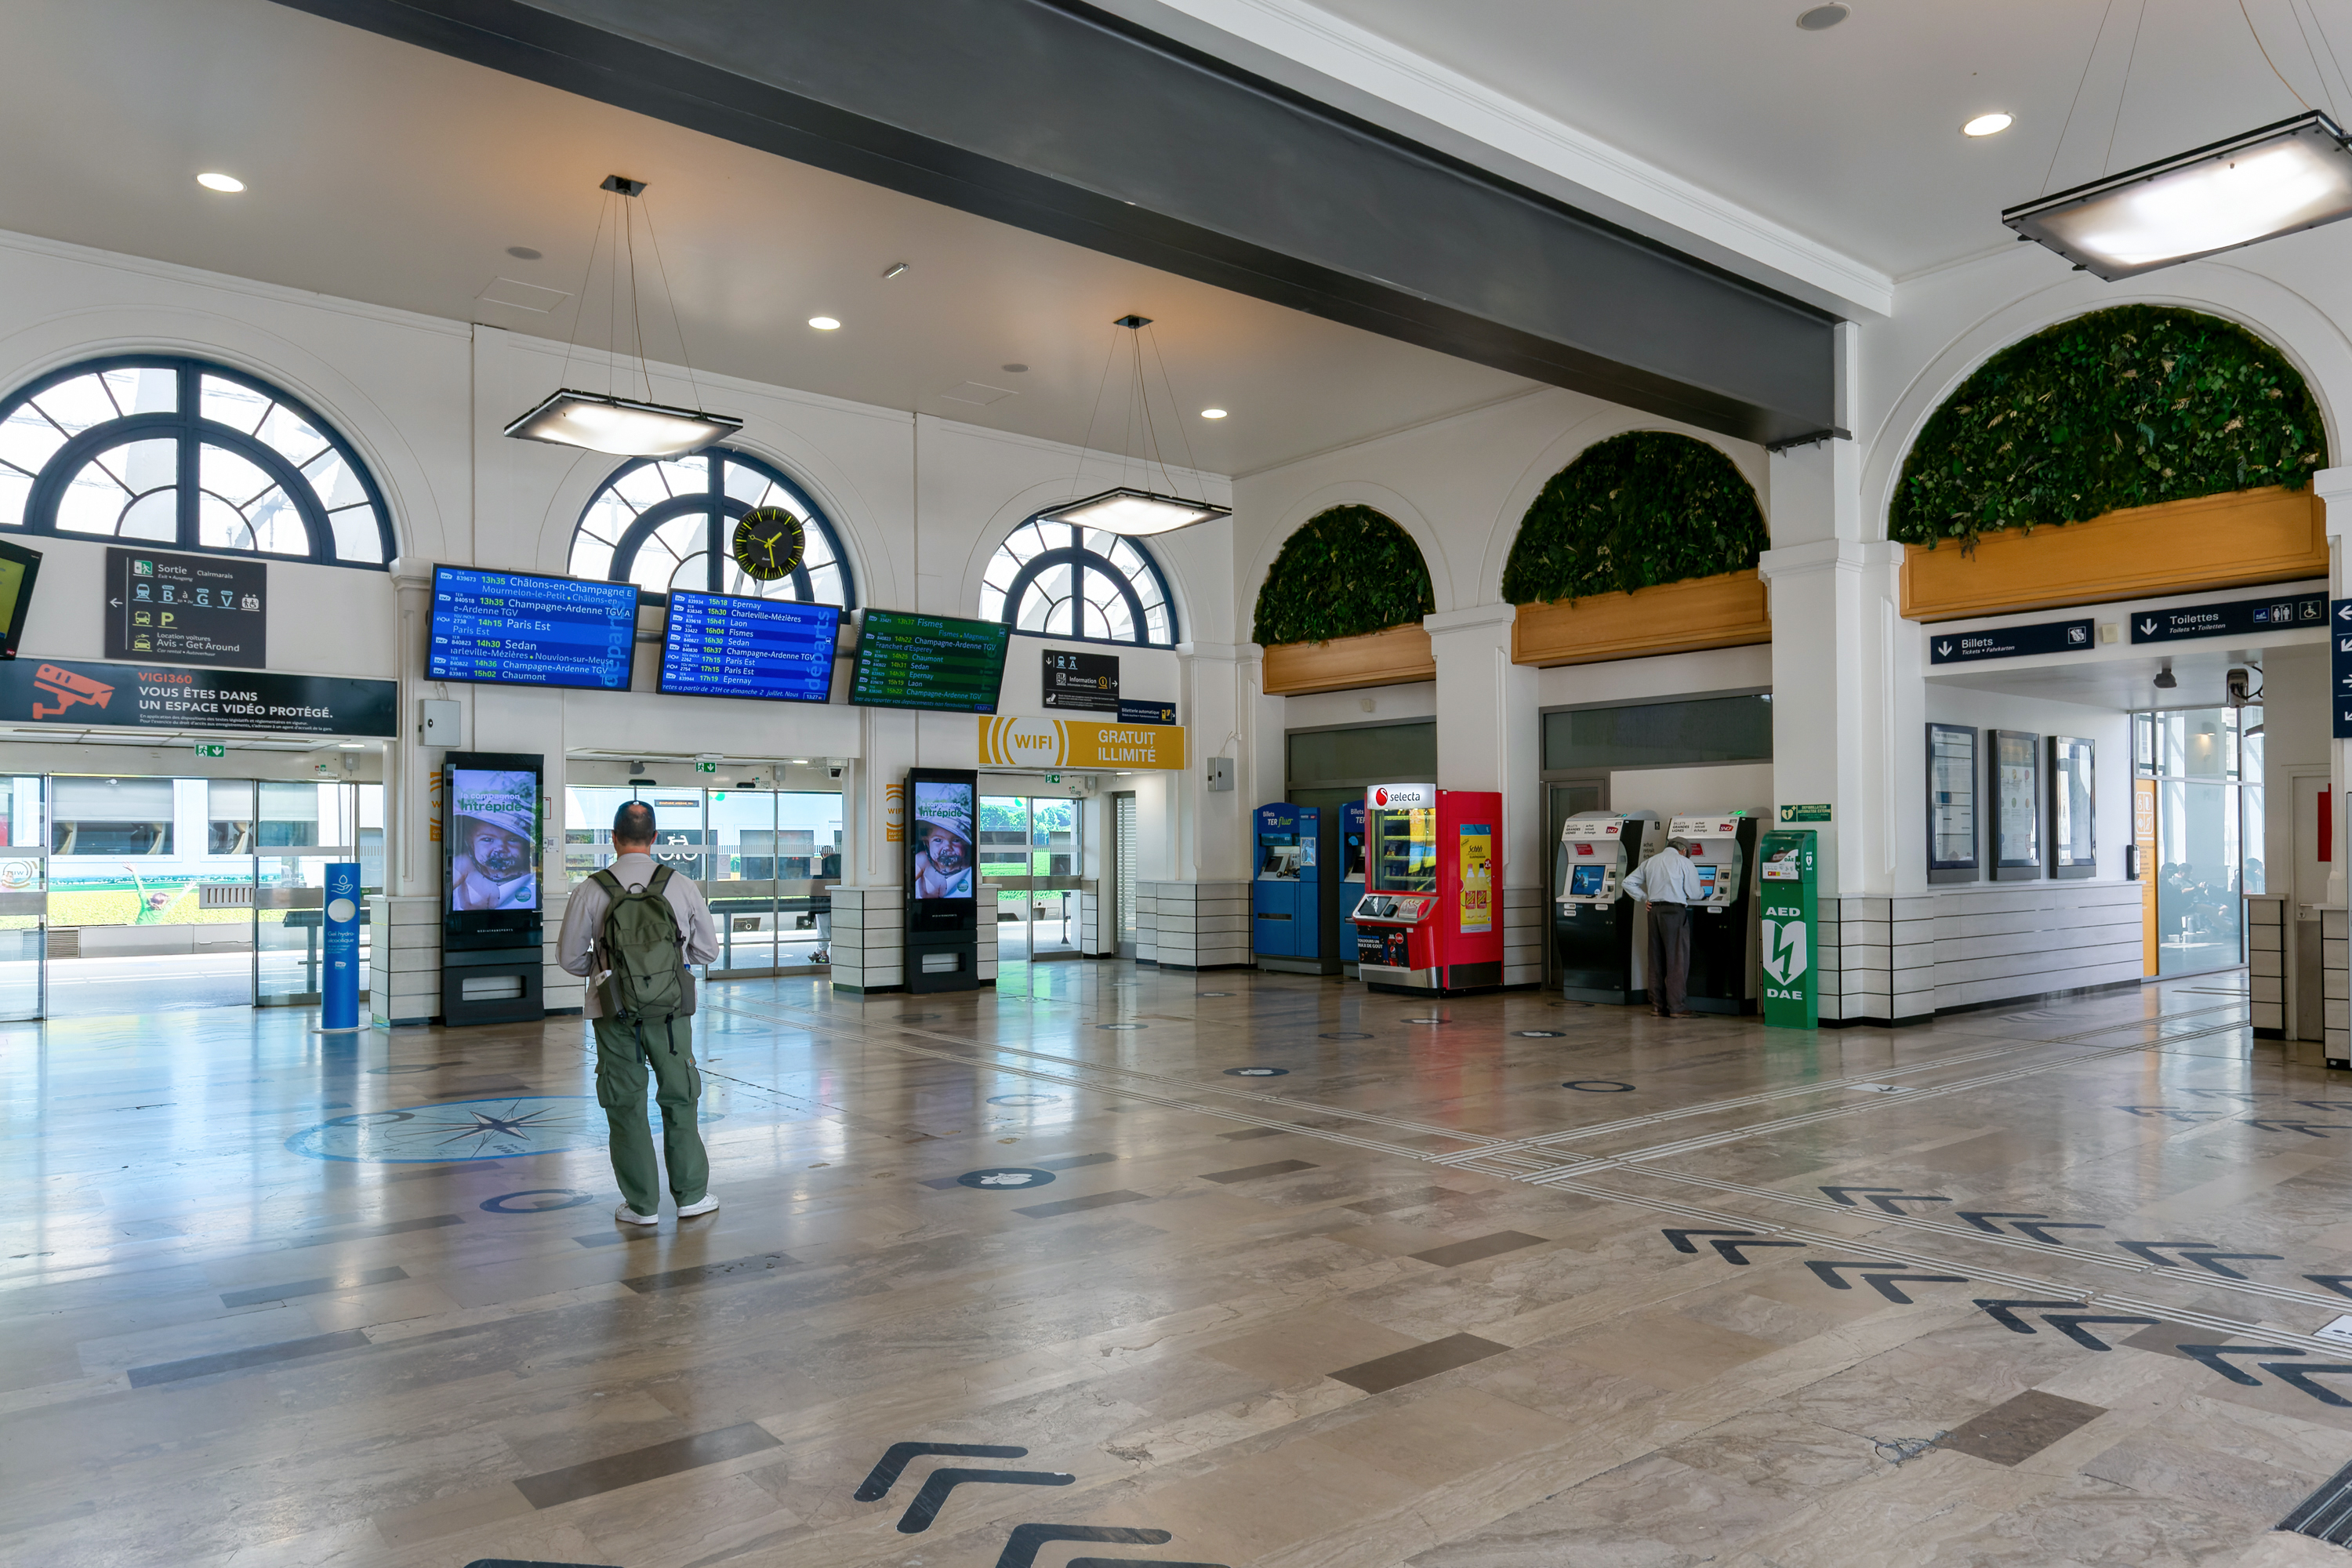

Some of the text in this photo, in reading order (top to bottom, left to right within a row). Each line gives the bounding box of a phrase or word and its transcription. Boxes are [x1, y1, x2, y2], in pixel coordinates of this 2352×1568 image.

[158, 564, 234, 579] Sortie Clairmarais
[481, 576, 506, 585] 13h35
[510, 577, 624, 597] Châlons-en-Champagne
[163, 590, 233, 607] B à G V
[481, 585, 566, 601] Mourmelon-le-Petit
[453, 604, 518, 617] e-Ardenne TGV
[480, 597, 504, 606] 13h35
[508, 598, 603, 615] Champagne-Ardenne
[605, 607, 623, 616] TGV
[732, 600, 762, 611] Epernay
[161, 612, 175, 626] P
[707, 608, 801, 622] 15h30 Charleville-Mézières
[2169, 613, 2220, 625] Toilettes
[478, 619, 503, 628] 14h15
[506, 619, 532, 630] Paris
[535, 621, 551, 631] Est
[730, 619, 748, 627] Laon
[917, 619, 943, 629] Fismes
[2198, 622, 2226, 631] Toiletten
[452, 625, 490, 636] Paris Est
[729, 629, 753, 637] Fismes
[157, 639, 240, 652] Avis Get Around
[476, 639, 537, 651] 14h30 Sedan
[728, 637, 750, 647] Sedan
[876, 641, 933, 654] Franchet d'Esperey
[914, 637, 982, 649] Champagne-Ardenne
[1962, 638, 1994, 649] Billets
[726, 648, 800, 660] Champagne-Ardenne
[804, 611, 830, 691] départs
[535, 652, 614, 665] Nouvion-sur-Meuse
[912, 654, 944, 662] Chaumont
[503, 660, 590, 673] Champagne-Ardenne
[591, 666, 608, 674] TGV
[1069, 660, 1076, 669] A
[138, 672, 193, 684] VIGI360
[502, 671, 546, 681] Chaumont
[723, 676, 752, 685] Epernay
[909, 671, 934, 681] Epernay
[139, 686, 258, 702] VOUS ÊTES DANS
[906, 688, 968, 699] Champagne-Ardenne
[139, 700, 333, 718] UN ESPACE VIDÉO PROTÉGÉ.
[1014, 734, 1053, 750] WIFI
[1098, 729, 1156, 745] GRATUIT
[1098, 746, 1156, 763] ILLIMITÉ
[1389, 792, 1421, 802] selecta
[460, 798, 522, 813] Intrépide
[920, 807, 963, 818] Intrépide
[1277, 816, 1294, 828] fluo
[1766, 906, 1801, 916] AED
[1767, 988, 1803, 1000] DAE
